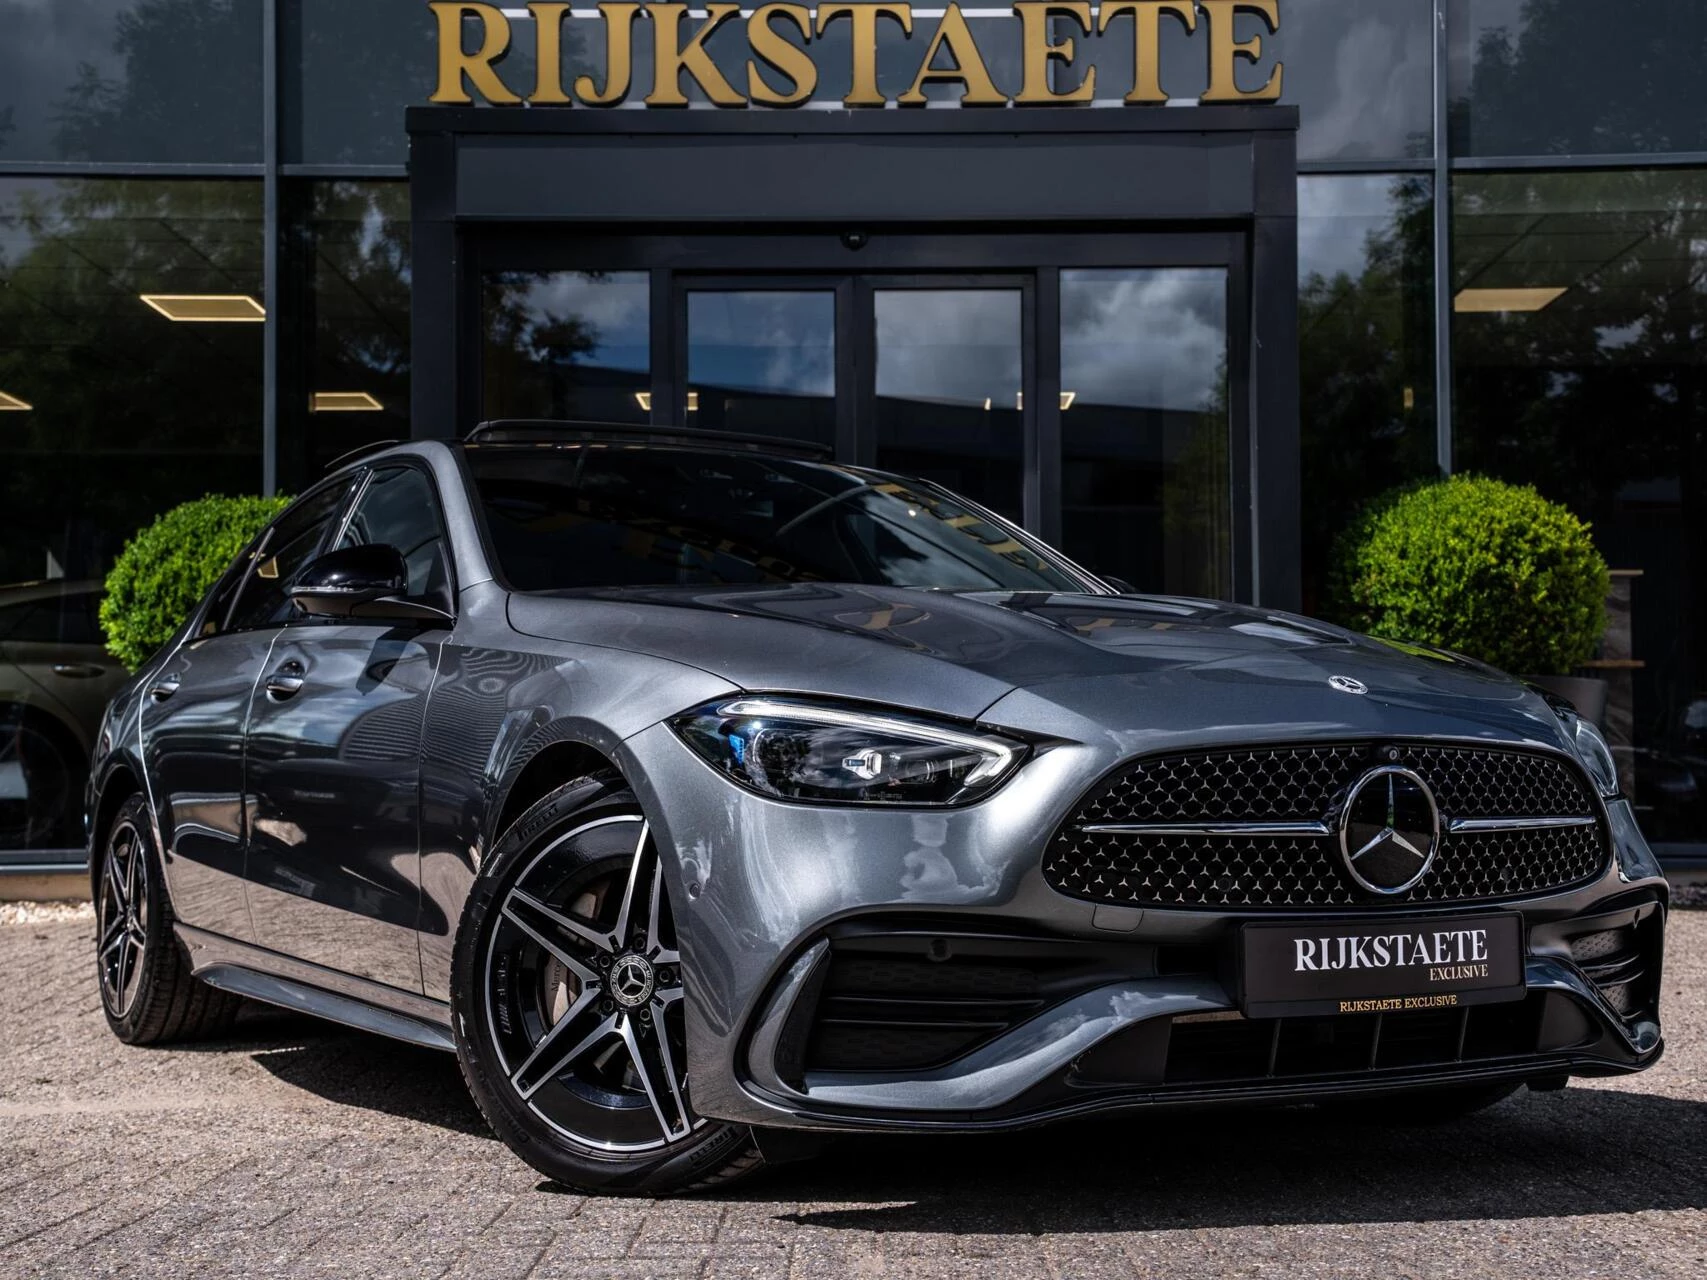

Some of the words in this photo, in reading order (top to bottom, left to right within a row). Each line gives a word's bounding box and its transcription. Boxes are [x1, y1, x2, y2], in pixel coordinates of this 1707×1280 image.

[428, 0, 1284, 107] RIJKSTAETE
[1294, 929, 1488, 972] RIJKSTAETE
[1430, 964, 1488, 981] EXCLUSIVE
[1340, 998, 1402, 1012] RIJKSTAETE
[1405, 995, 1457, 1009] EXCLUSIVE
